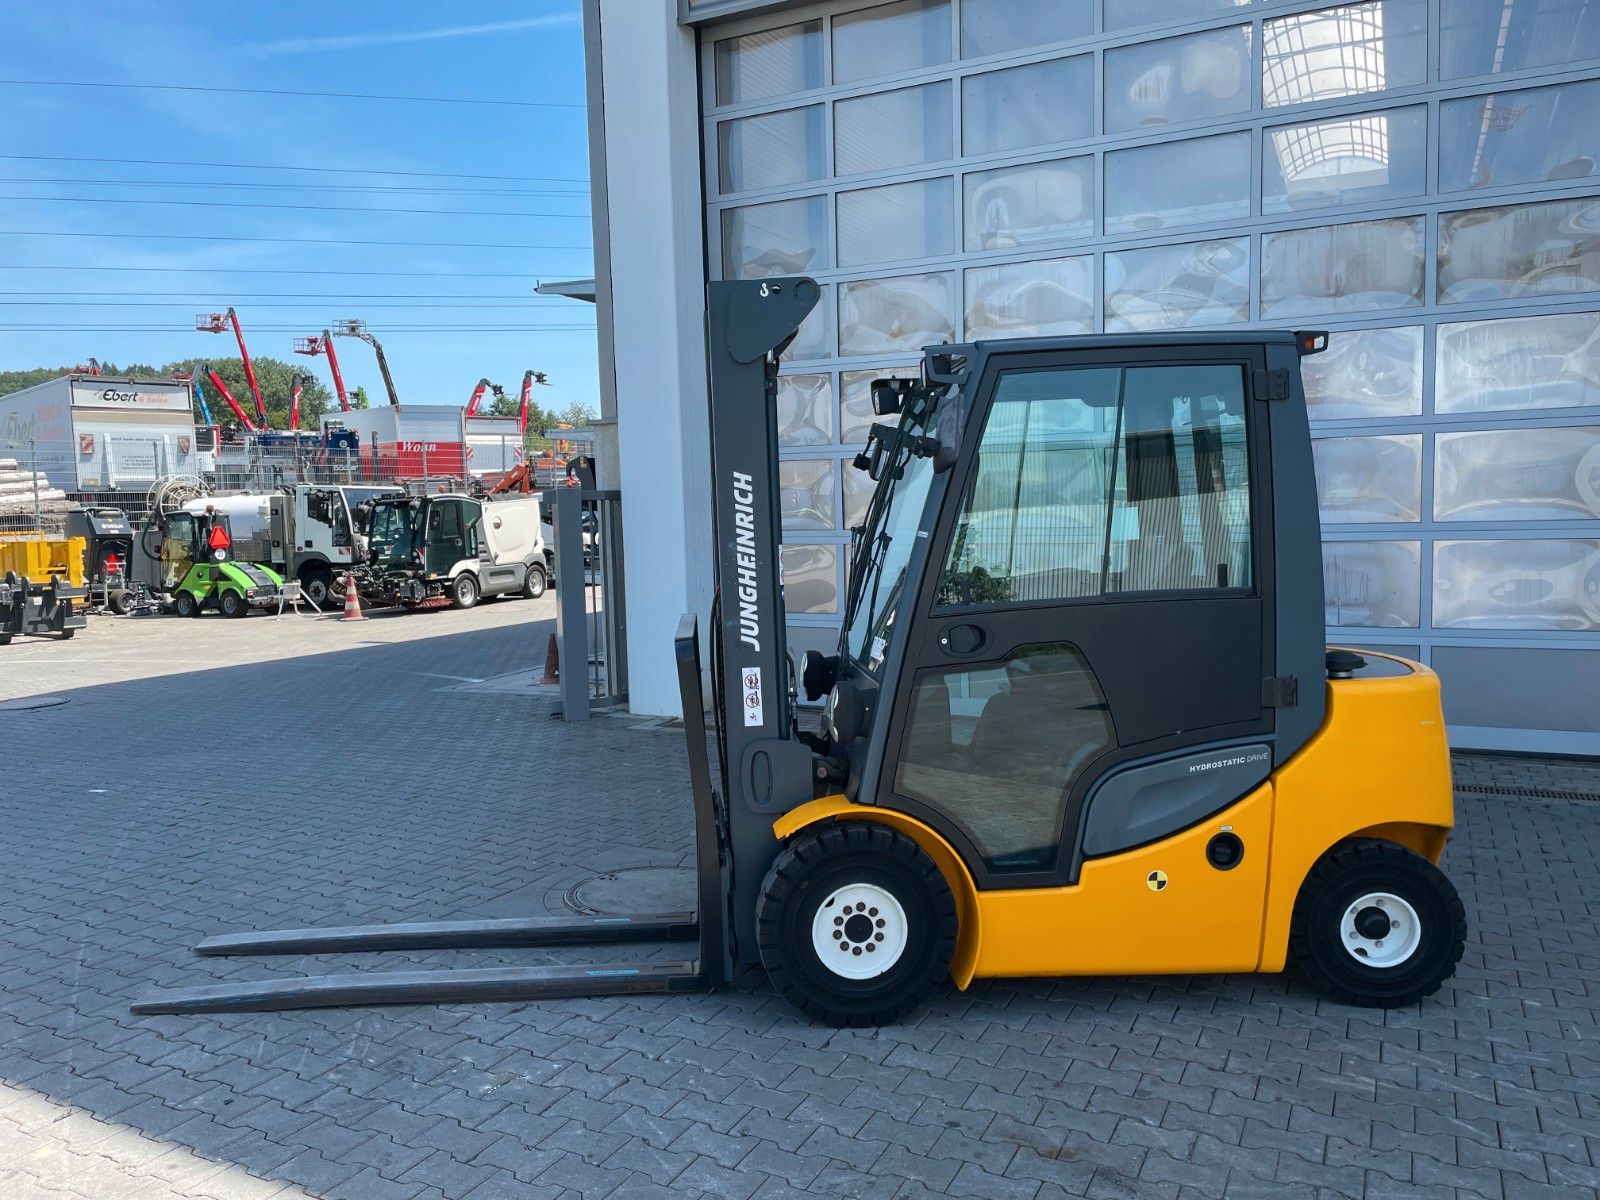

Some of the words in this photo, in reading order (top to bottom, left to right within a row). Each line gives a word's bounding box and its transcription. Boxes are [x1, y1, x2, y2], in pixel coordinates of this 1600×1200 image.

[103, 388, 138, 402] Ebert
[733, 471, 760, 652] JUNGHEINRICH
[1189, 757, 1246, 772] HYDROSTATIC
[1246, 753, 1269, 763] DRIVE
